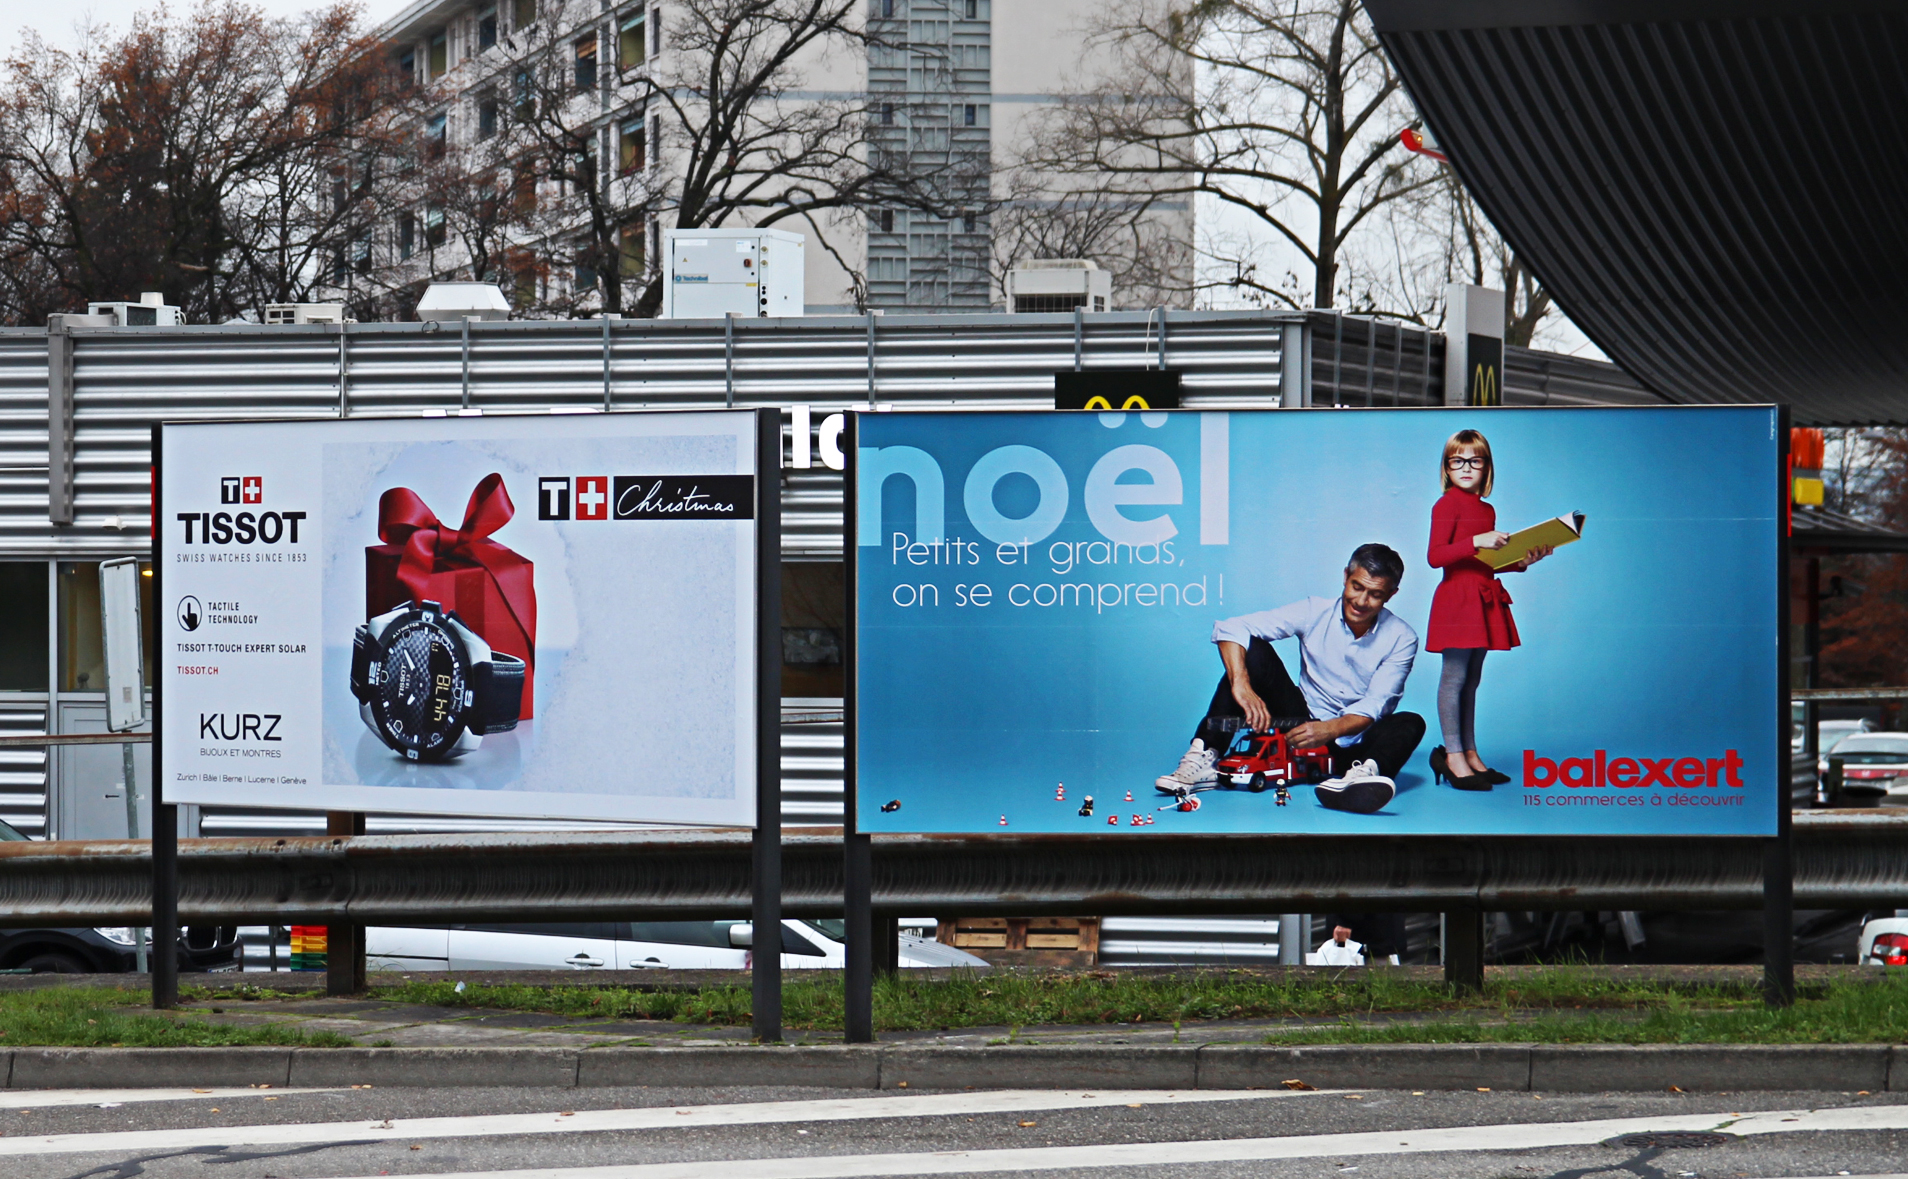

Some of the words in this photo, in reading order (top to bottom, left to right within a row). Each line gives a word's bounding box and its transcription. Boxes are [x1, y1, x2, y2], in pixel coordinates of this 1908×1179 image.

[858, 412, 1230, 547] noël
[617, 480, 734, 516] Christmas
[177, 511, 307, 545] TISSOT
[177, 553, 206, 563] SWISS
[209, 553, 251, 563] WATCHES
[256, 553, 283, 563] SINCE
[287, 553, 307, 563] 1853
[892, 532, 980, 565] Petits
[996, 535, 1034, 565] et
[1049, 535, 1185, 574] grands,
[892, 583, 938, 606] on
[955, 583, 993, 606] se
[208, 602, 240, 611] TACTILE
[208, 615, 258, 625] TECHNOLOGY
[177, 643, 206, 653] TISSOT
[207, 643, 242, 653] T-TOUCH
[244, 643, 275, 653] EXPERT
[278, 644, 307, 653] SOLAR
[177, 666, 219, 676] TISSOT.CH
[398, 664, 407, 698] TISSOT
[200, 713, 283, 741] KURZ
[230, 748, 241, 758] ET
[242, 748, 282, 758] MONTRES
[1522, 749, 1744, 789] balexert
[177, 773, 198, 782] Zurich
[203, 773, 218, 783] Bâle
[222, 774, 243, 783] Berne
[247, 774, 275, 784] Lucerne
[280, 774, 307, 785] Genève
[1523, 795, 1541, 806] 115
[1545, 795, 1644, 806] commerces
[1650, 793, 1662, 806] à
[1667, 792, 1745, 806] découvrir
